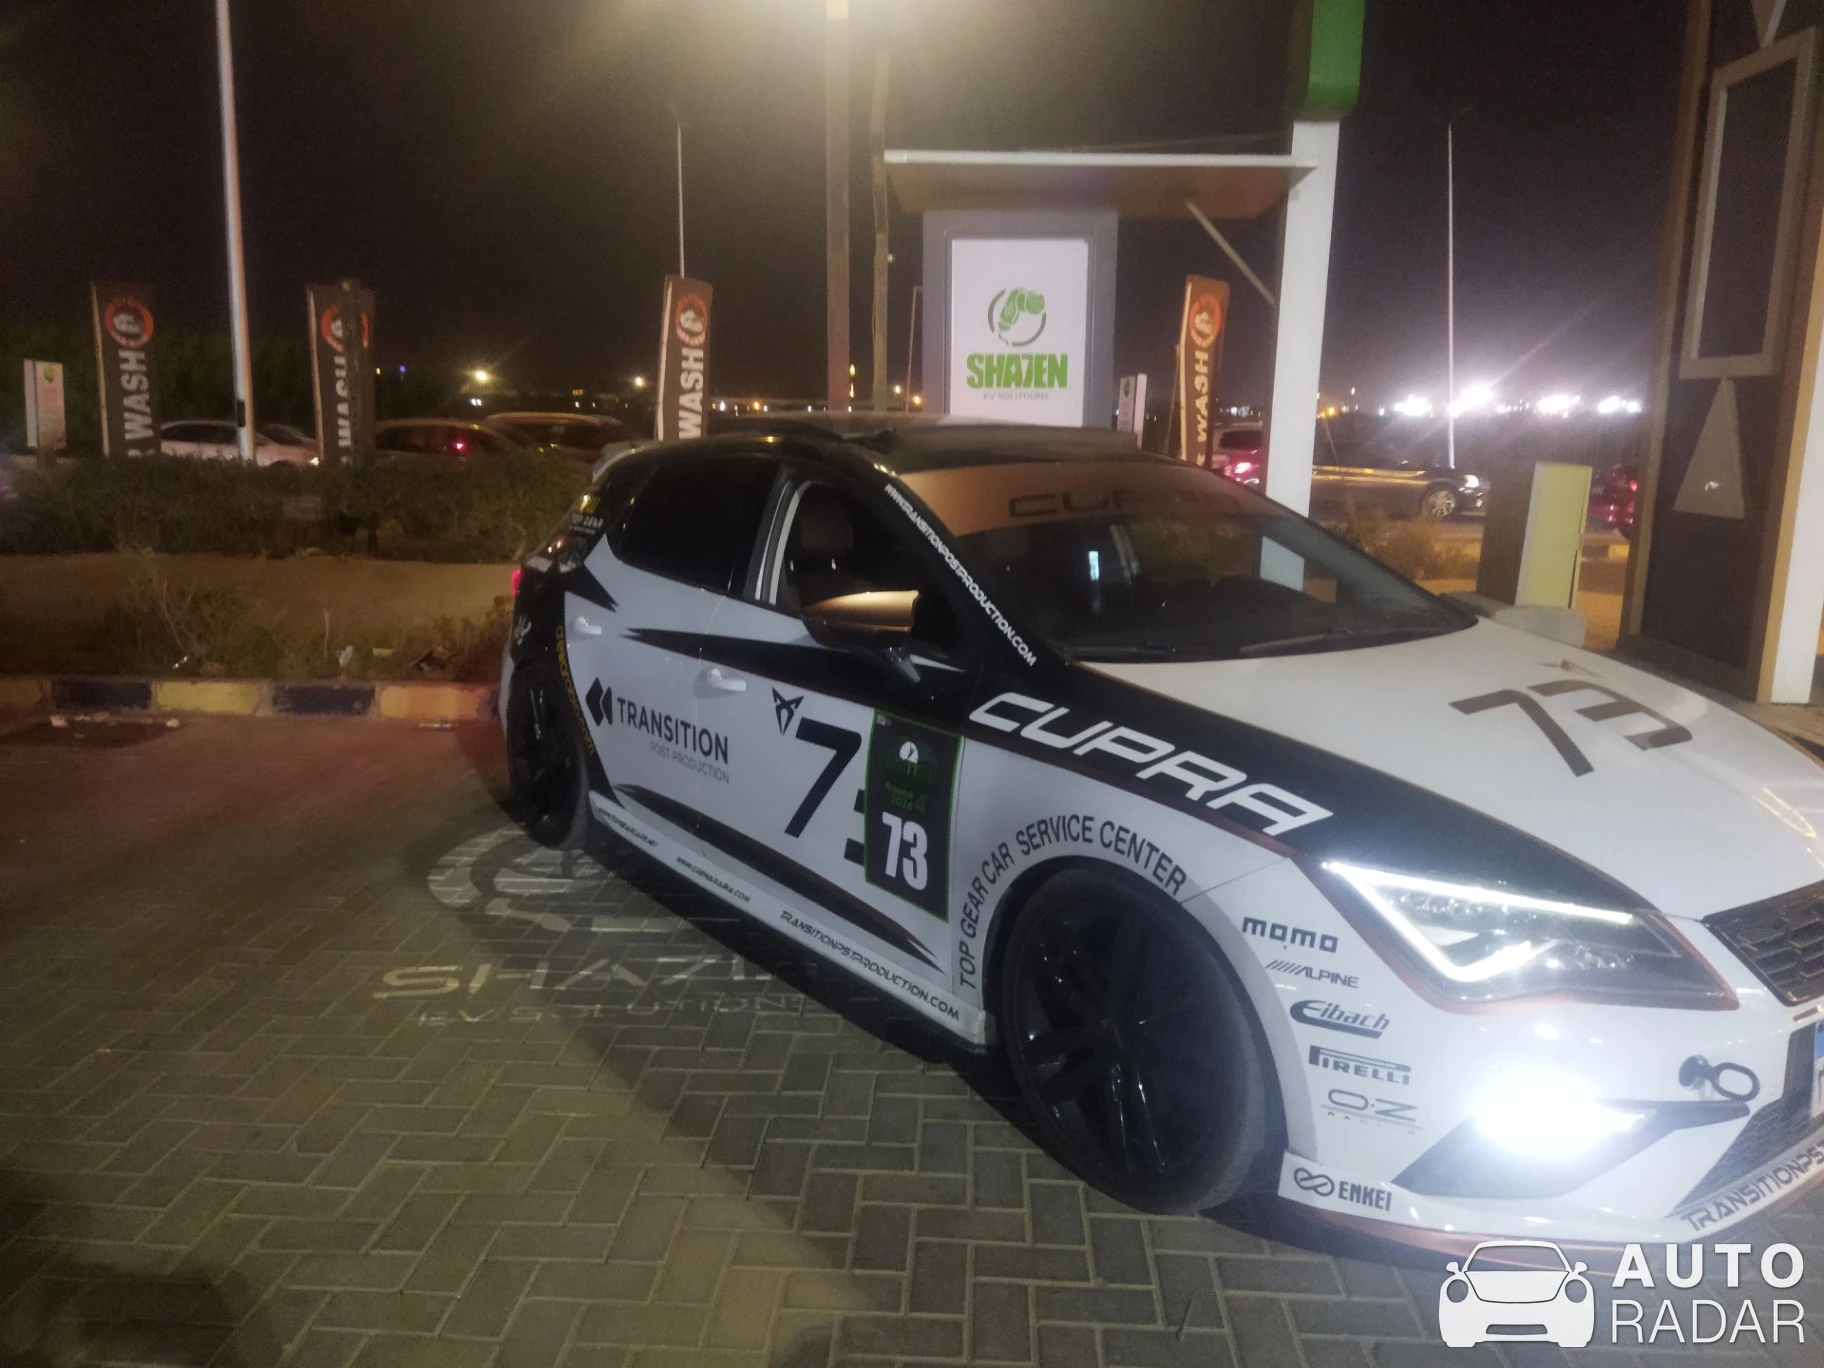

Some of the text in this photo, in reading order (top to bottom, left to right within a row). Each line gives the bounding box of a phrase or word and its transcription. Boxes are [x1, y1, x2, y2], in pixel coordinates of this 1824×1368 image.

[118, 350, 153, 441] WASH
[678, 347, 704, 439] WASH
[1194, 351, 1209, 442] WASH
[616, 696, 729, 765] TRANSITION
[650, 741, 730, 784] POST PRODUCTION
[969, 691, 1335, 836] CUPRA
[1448, 679, 1694, 778] 73
[784, 716, 866, 868] 7
[882, 811, 928, 891] 73
[960, 814, 1188, 988] TOP GEAR CAR SERVICE CENTER
[1290, 963, 1360, 989] ALPINE
[1290, 999, 1391, 1037] Eibach
[1308, 1044, 1411, 1086] PIRELLI
[1338, 1180, 1393, 1212] ENKEI
